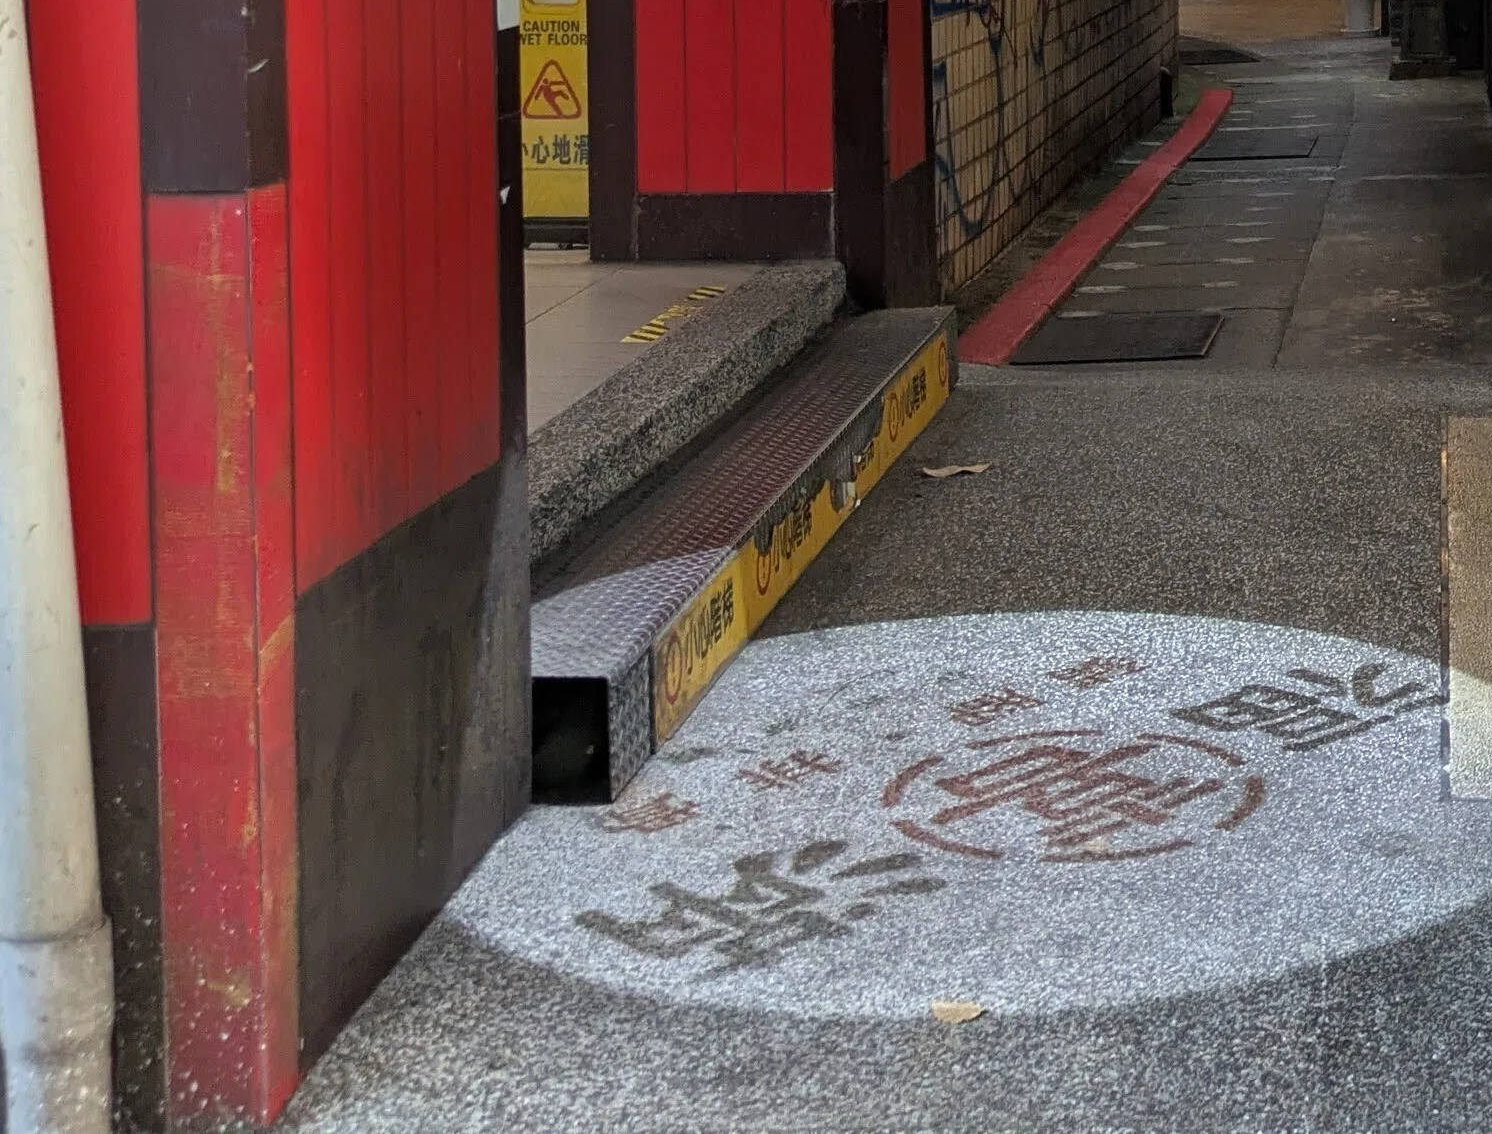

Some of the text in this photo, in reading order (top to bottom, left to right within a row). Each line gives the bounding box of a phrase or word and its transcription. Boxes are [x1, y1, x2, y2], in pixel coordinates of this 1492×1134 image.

[523, 20, 580, 33] CAUTION
[548, 33, 587, 46] FLOOR
[522, 133, 588, 165] 心地滑
